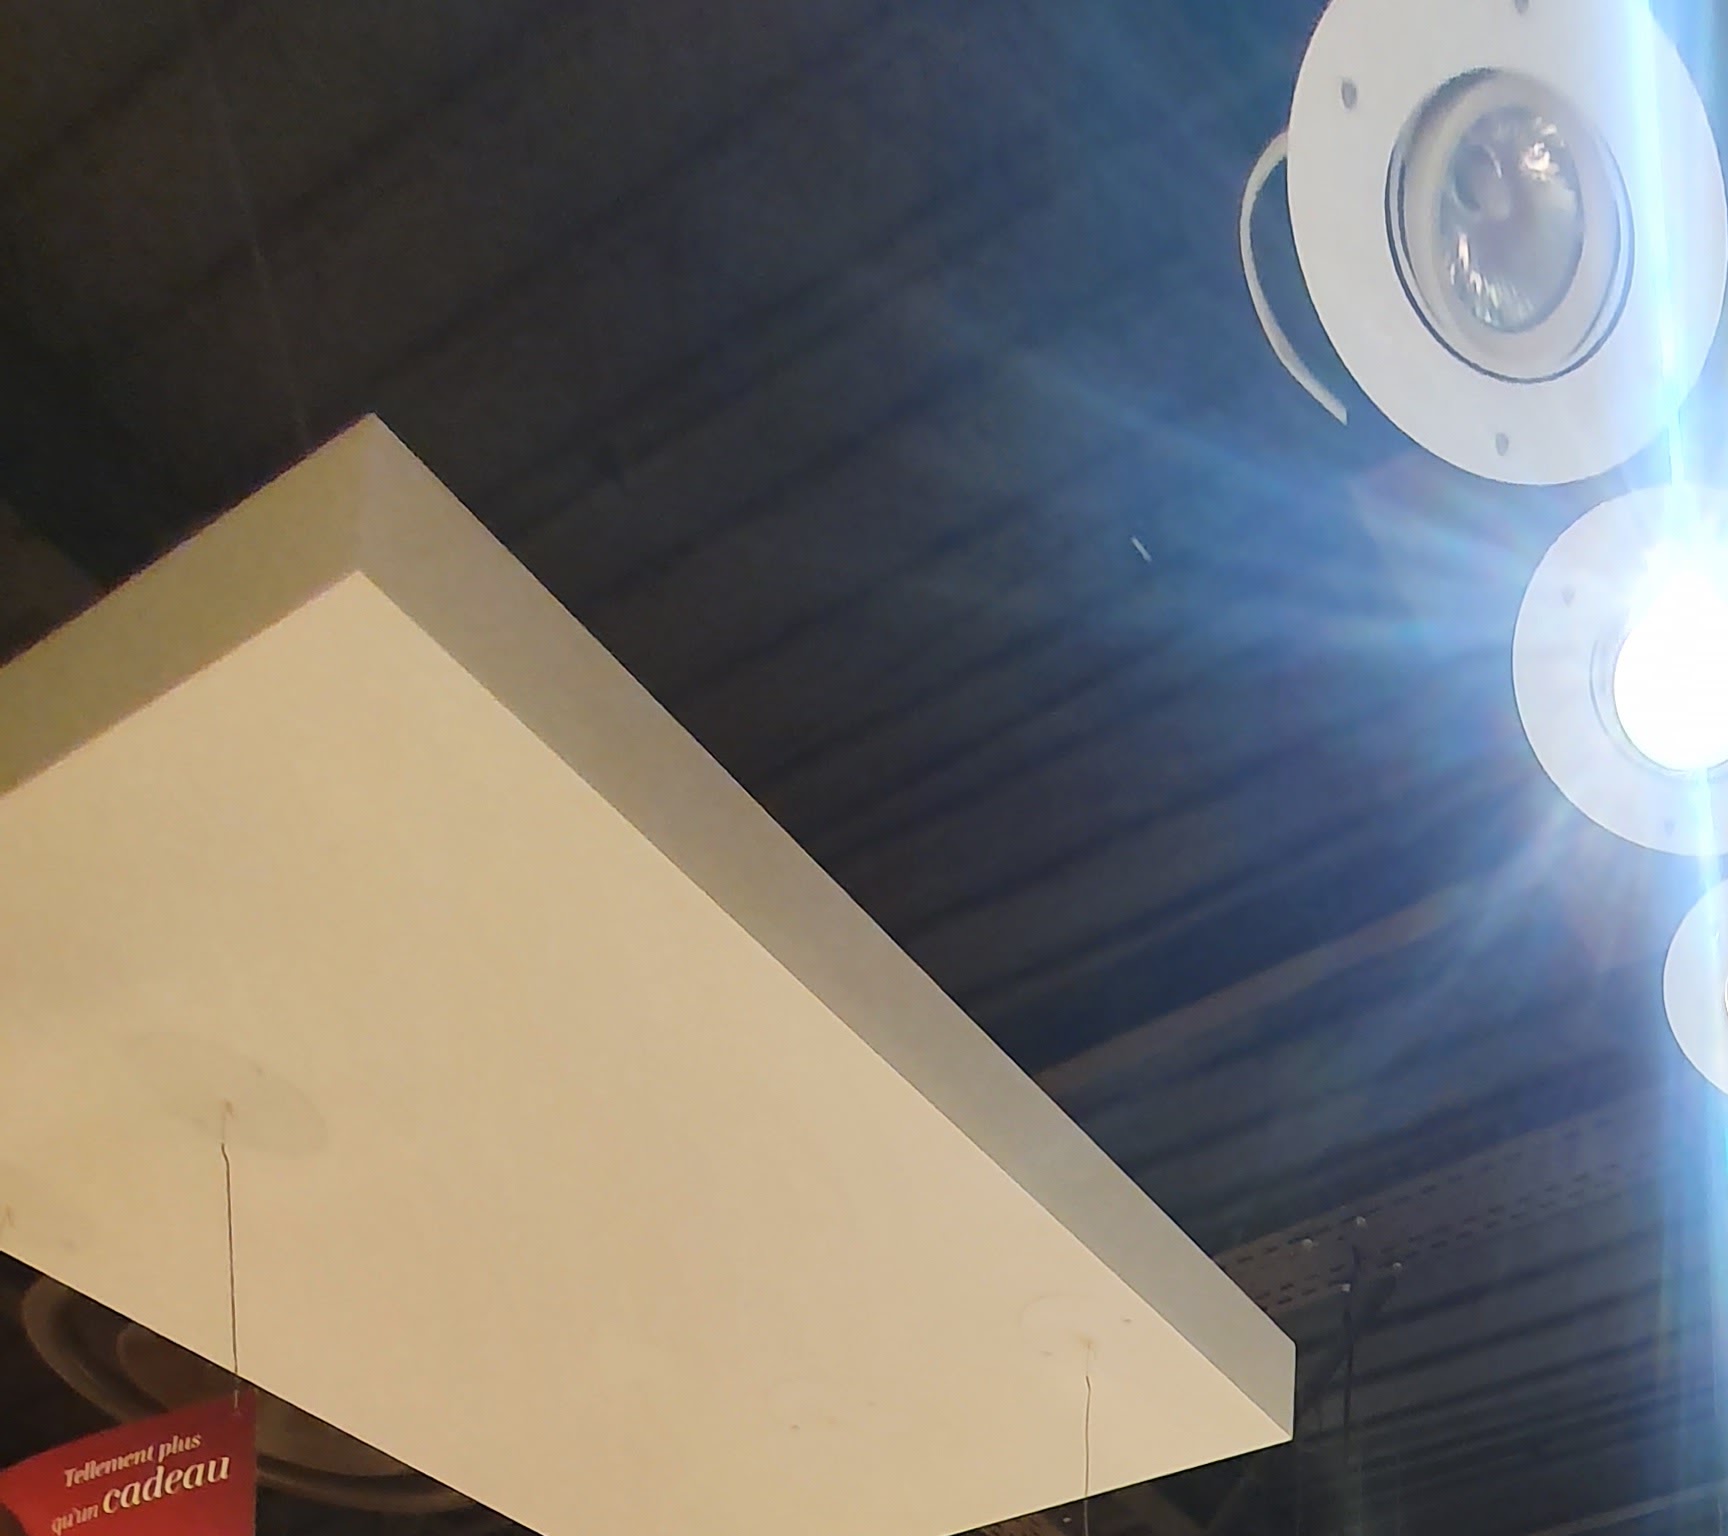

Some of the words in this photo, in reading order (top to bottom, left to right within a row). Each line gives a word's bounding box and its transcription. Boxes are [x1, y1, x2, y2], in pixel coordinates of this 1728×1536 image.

[64, 1445, 154, 1487] Tellement
[157, 1433, 203, 1462] plus
[51, 1504, 99, 1536] qu'un
[102, 1456, 231, 1514] cadeau
